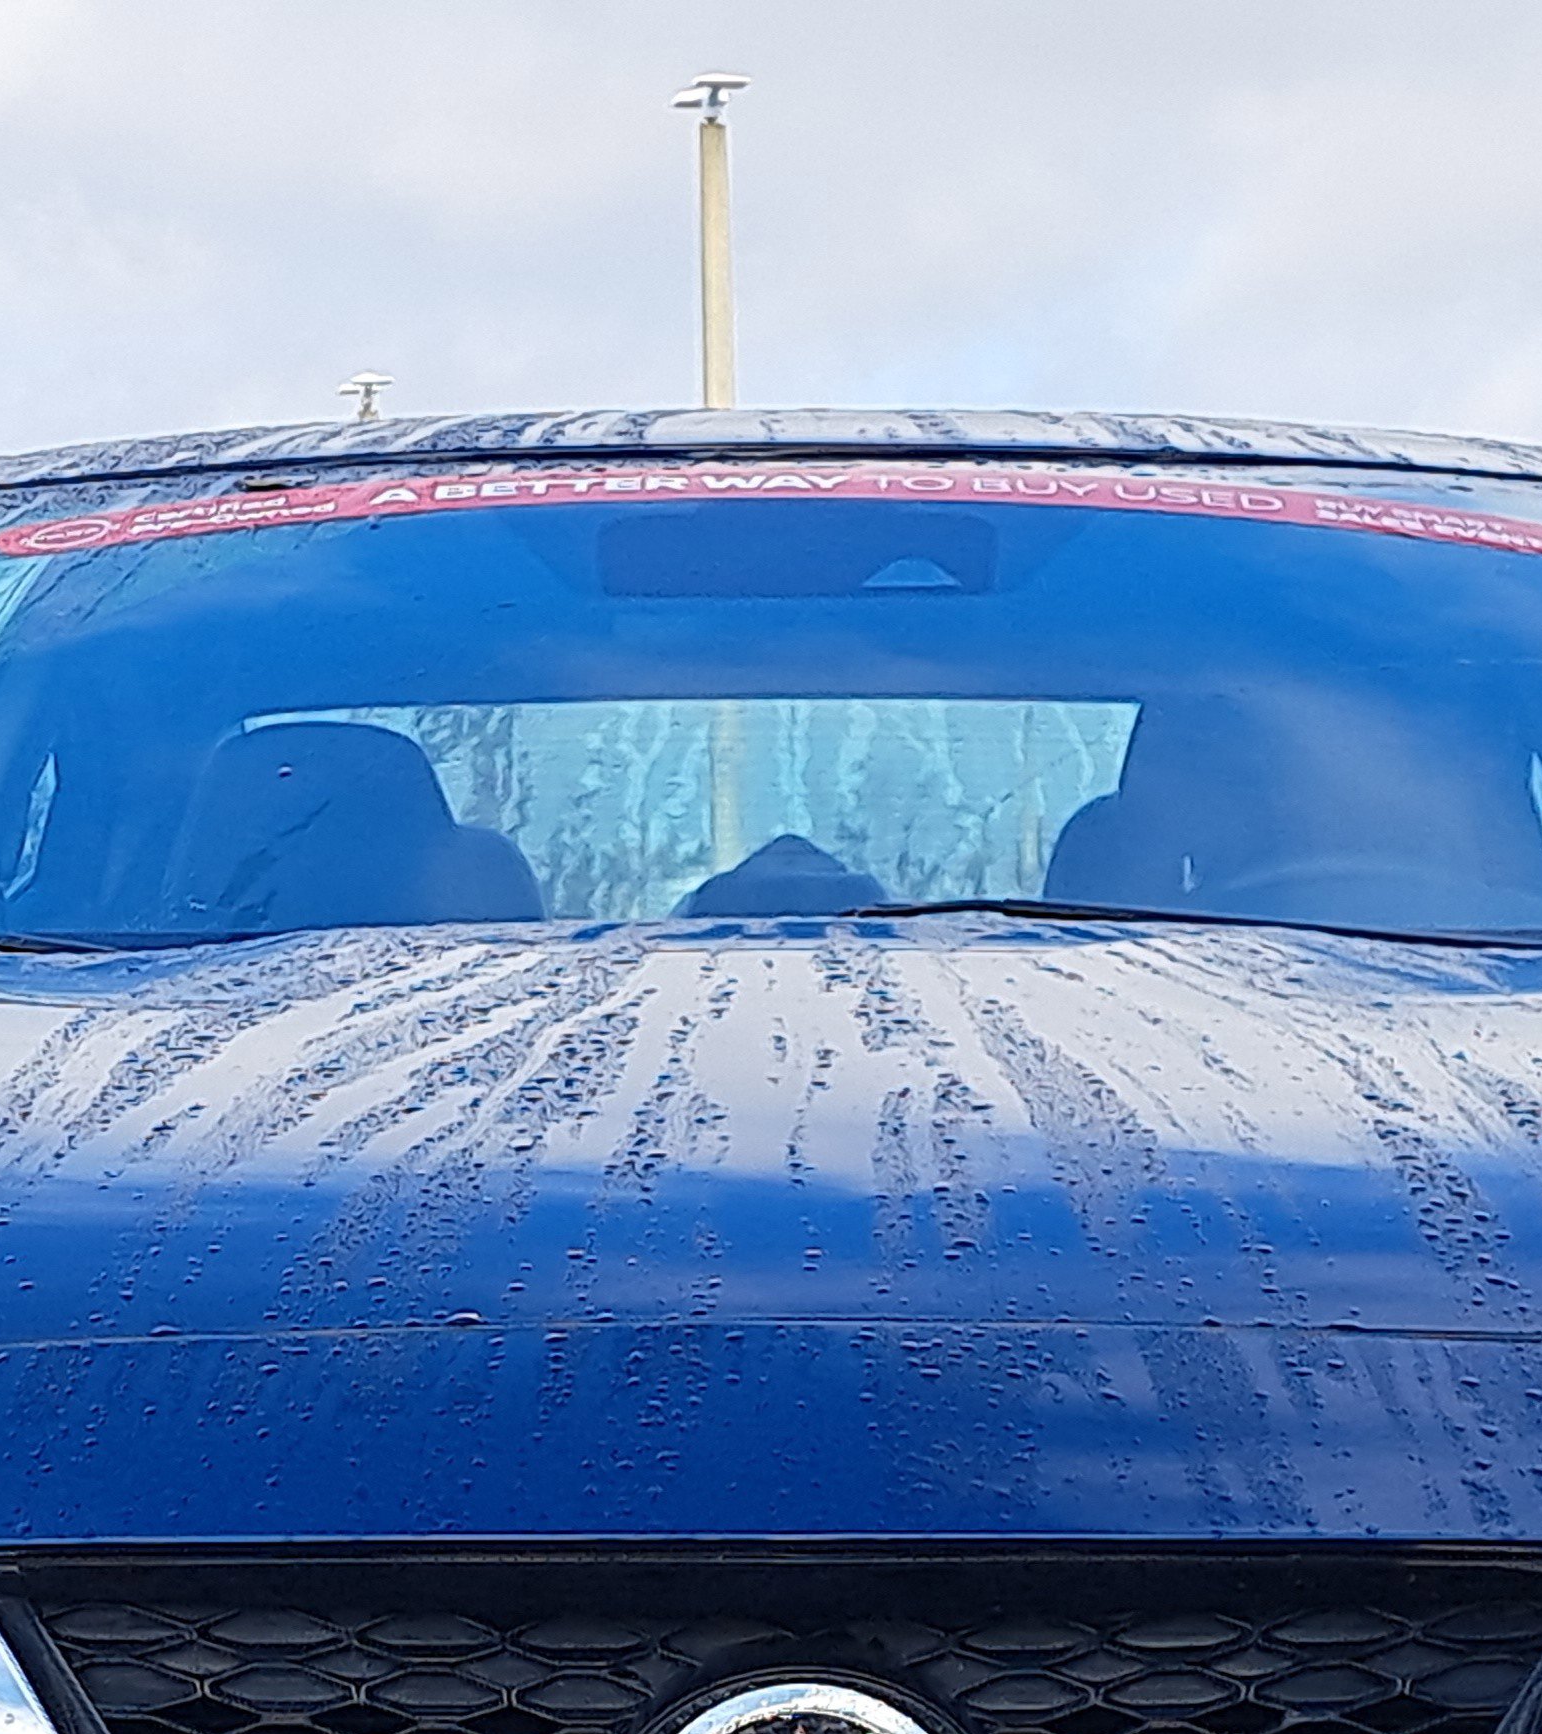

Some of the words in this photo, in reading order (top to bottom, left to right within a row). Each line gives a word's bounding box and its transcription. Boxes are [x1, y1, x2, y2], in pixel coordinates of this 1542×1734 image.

[369, 487, 419, 505] A
[433, 475, 689, 501] BETTER
[700, 474, 851, 490] WAY
[861, 474, 954, 492] TO
[972, 476, 1099, 497] BUY
[1114, 483, 1284, 511] USED
